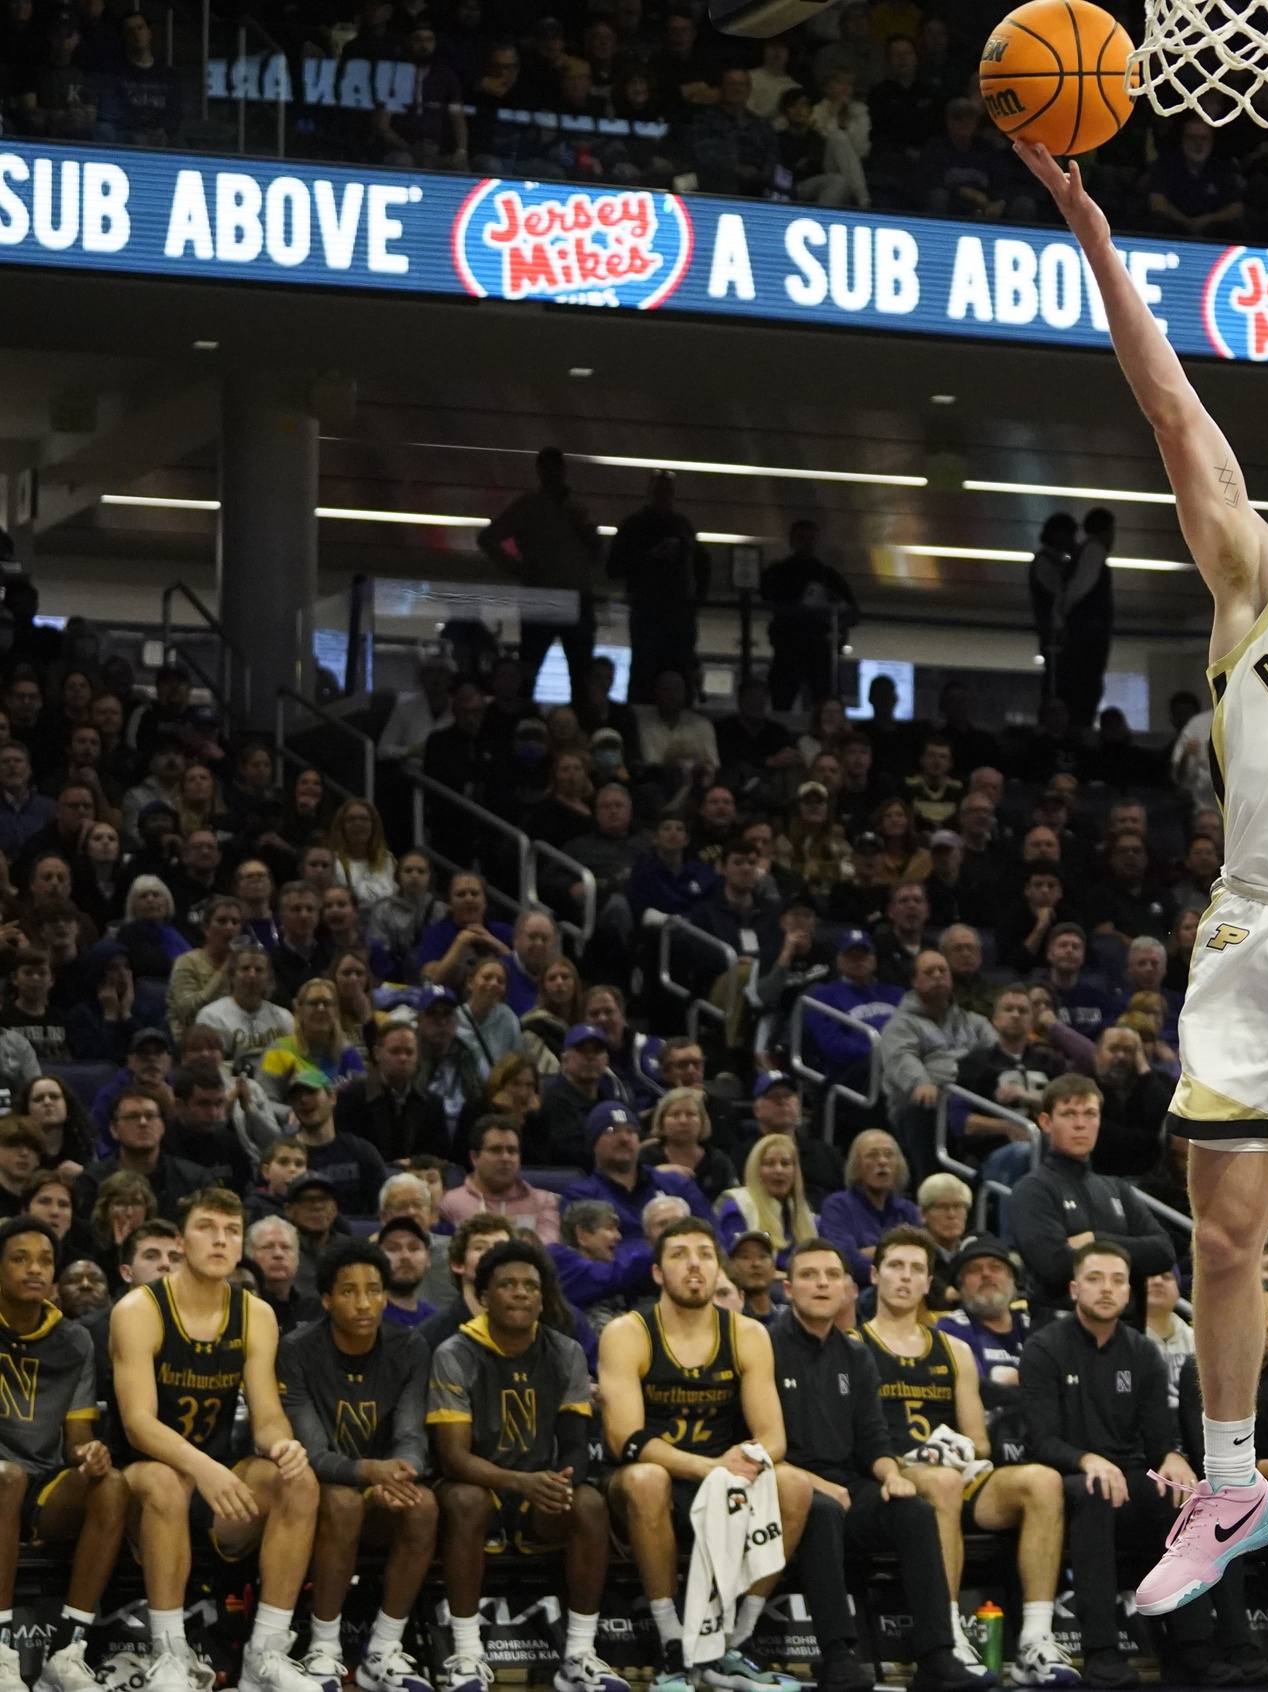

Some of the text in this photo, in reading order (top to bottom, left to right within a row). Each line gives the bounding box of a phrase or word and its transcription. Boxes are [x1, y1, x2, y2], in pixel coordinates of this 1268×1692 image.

[0, 154, 410, 275] SUB ABOVE
[486, 192, 656, 246] Jersey
[506, 236, 660, 295] Mike's
[707, 214, 756, 300] A
[784, 218, 920, 314] SUB
[1205, 923, 1250, 951] P
[0, 1353, 39, 1422] N
[879, 1381, 952, 1401] orthwestern
[1116, 1370, 1132, 1392] N
[177, 1396, 222, 1444] 33
[333, 1401, 378, 1459] N
[498, 1388, 537, 1452] N
[905, 1400, 931, 1443] 5
[481, 1650, 561, 1660] UMBURG KIA
[487, 1640, 550, 1649] ROHRMAN
